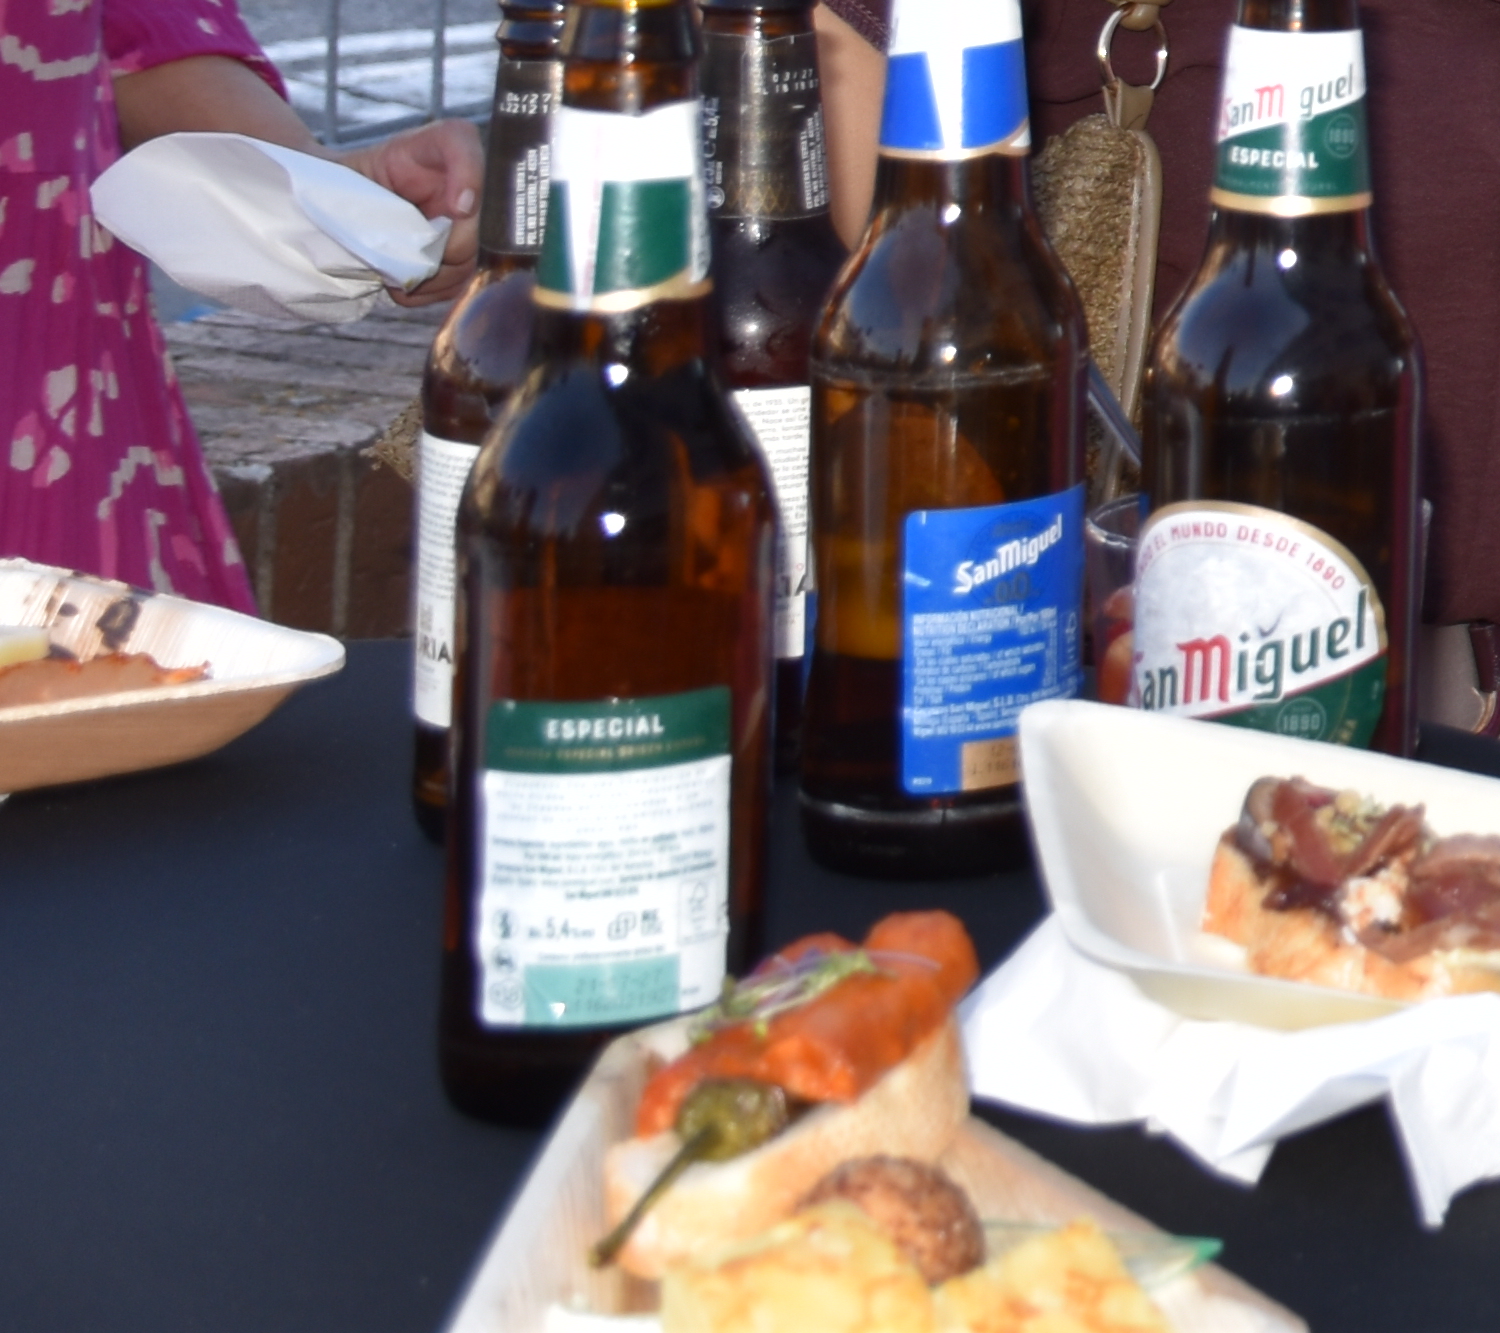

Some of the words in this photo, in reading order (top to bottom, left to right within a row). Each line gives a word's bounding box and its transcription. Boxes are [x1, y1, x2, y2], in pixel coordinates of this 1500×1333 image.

[954, 513, 1063, 594] SanMiguel
[1171, 521, 1228, 540] MUNDO
[1236, 524, 1301, 558] DESDE
[546, 714, 665, 741] ESPECIAL
